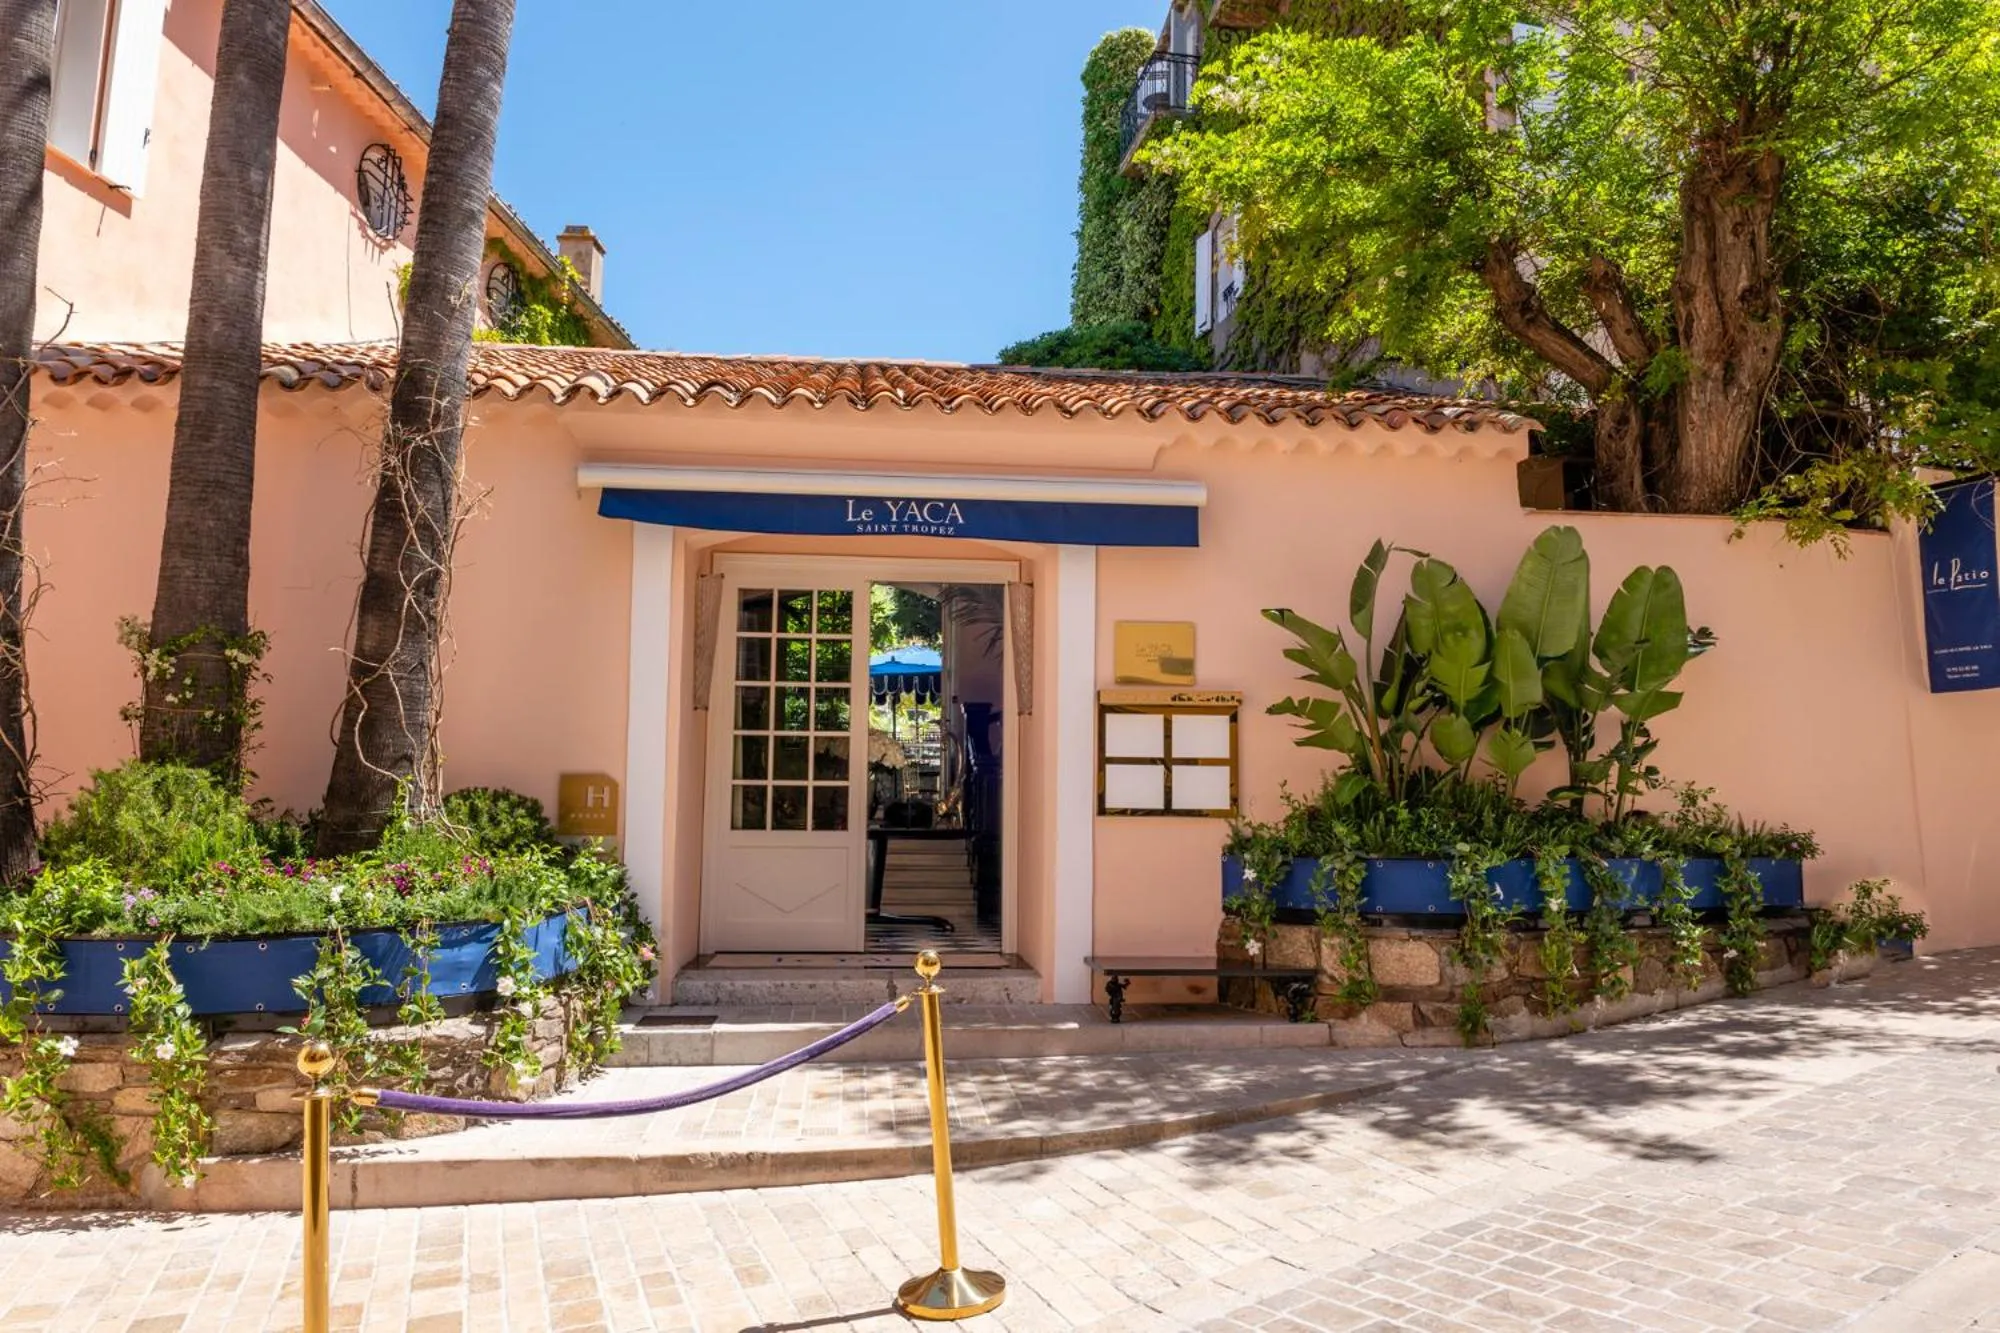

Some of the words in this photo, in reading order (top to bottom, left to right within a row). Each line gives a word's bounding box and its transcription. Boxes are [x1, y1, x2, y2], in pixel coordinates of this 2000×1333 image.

[846, 499, 874, 521] Le
[884, 500, 964, 524] YACA
[856, 524, 897, 533] SAINT
[903, 524, 955, 535] TROPEZ
[1950, 558, 1990, 590] Patio
[587, 786, 610, 808] H
